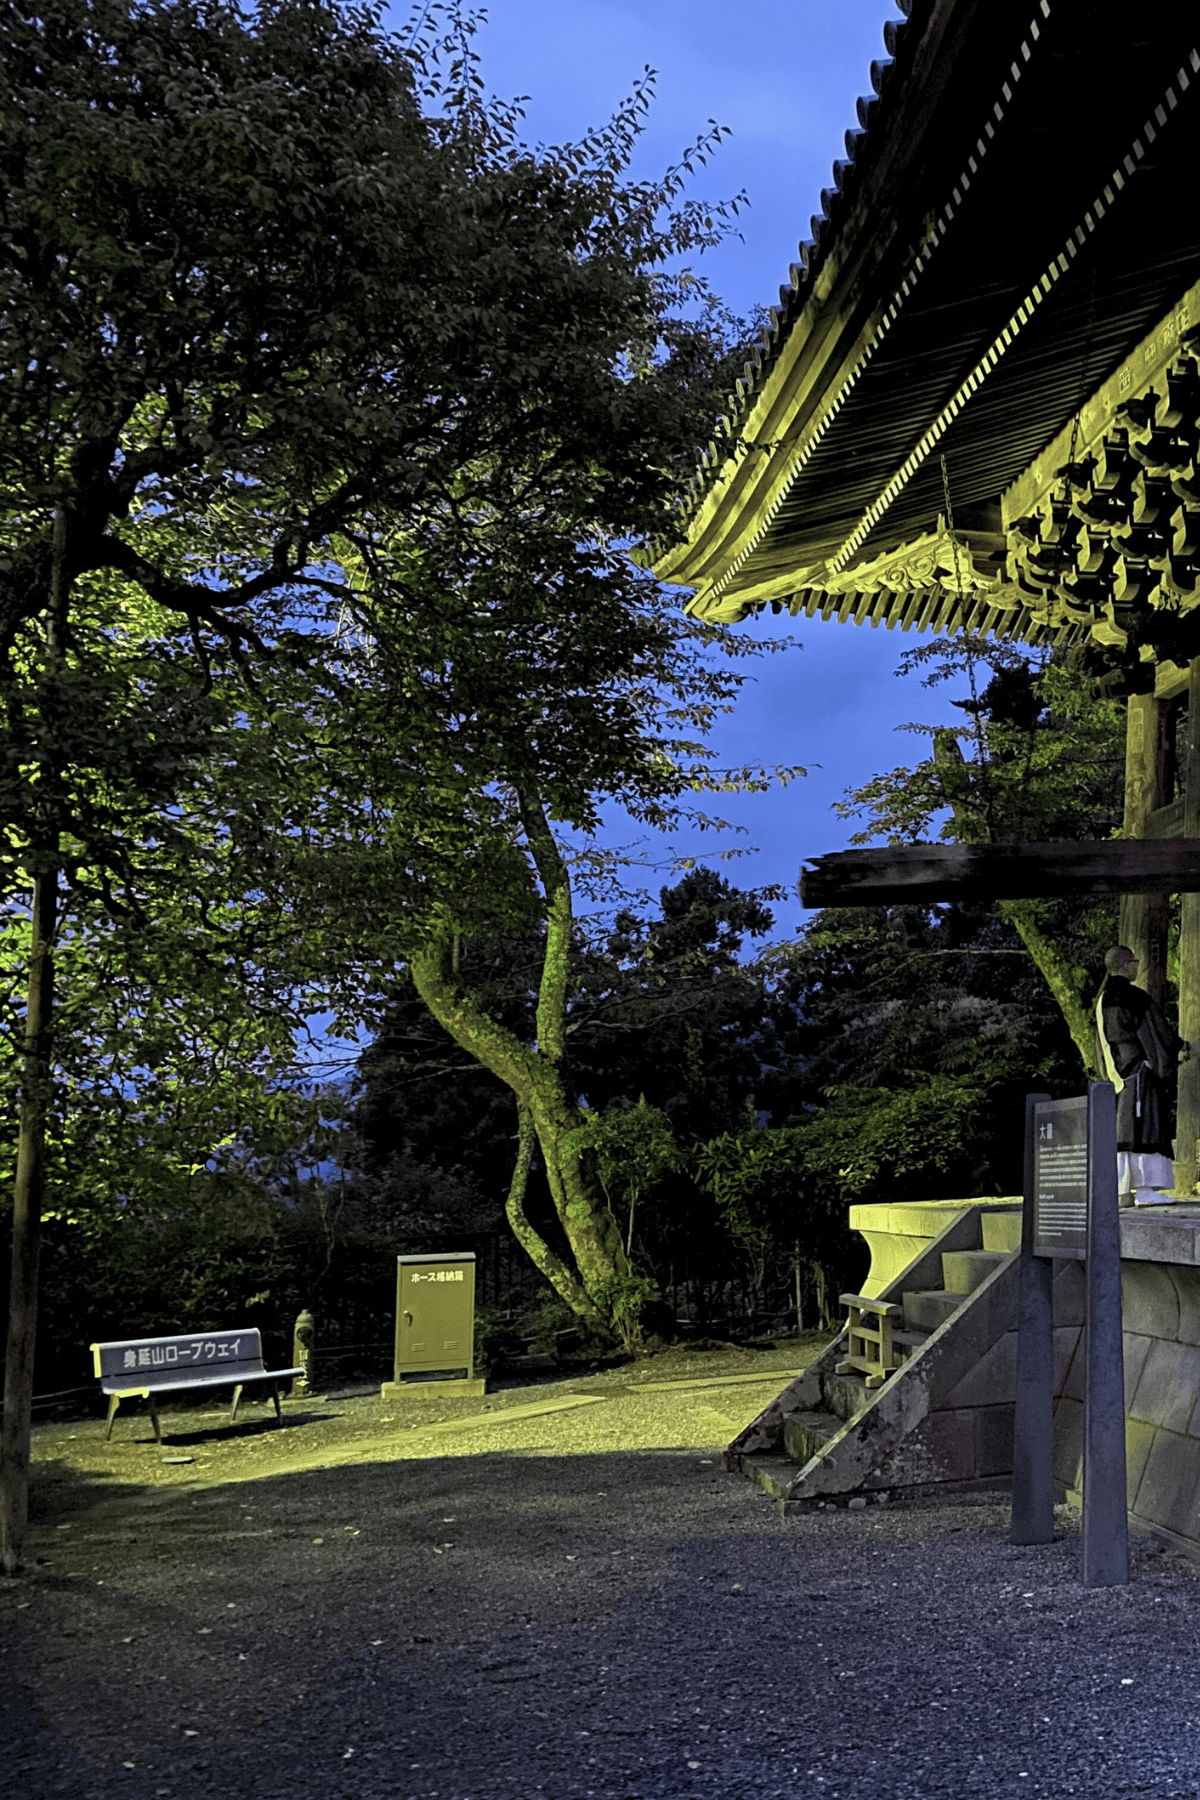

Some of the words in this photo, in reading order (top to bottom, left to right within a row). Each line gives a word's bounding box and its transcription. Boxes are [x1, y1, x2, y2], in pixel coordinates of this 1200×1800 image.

[411, 1270, 464, 1283] ホース格納箱
[123, 1338, 242, 1369] 身延山ロープウェイ
